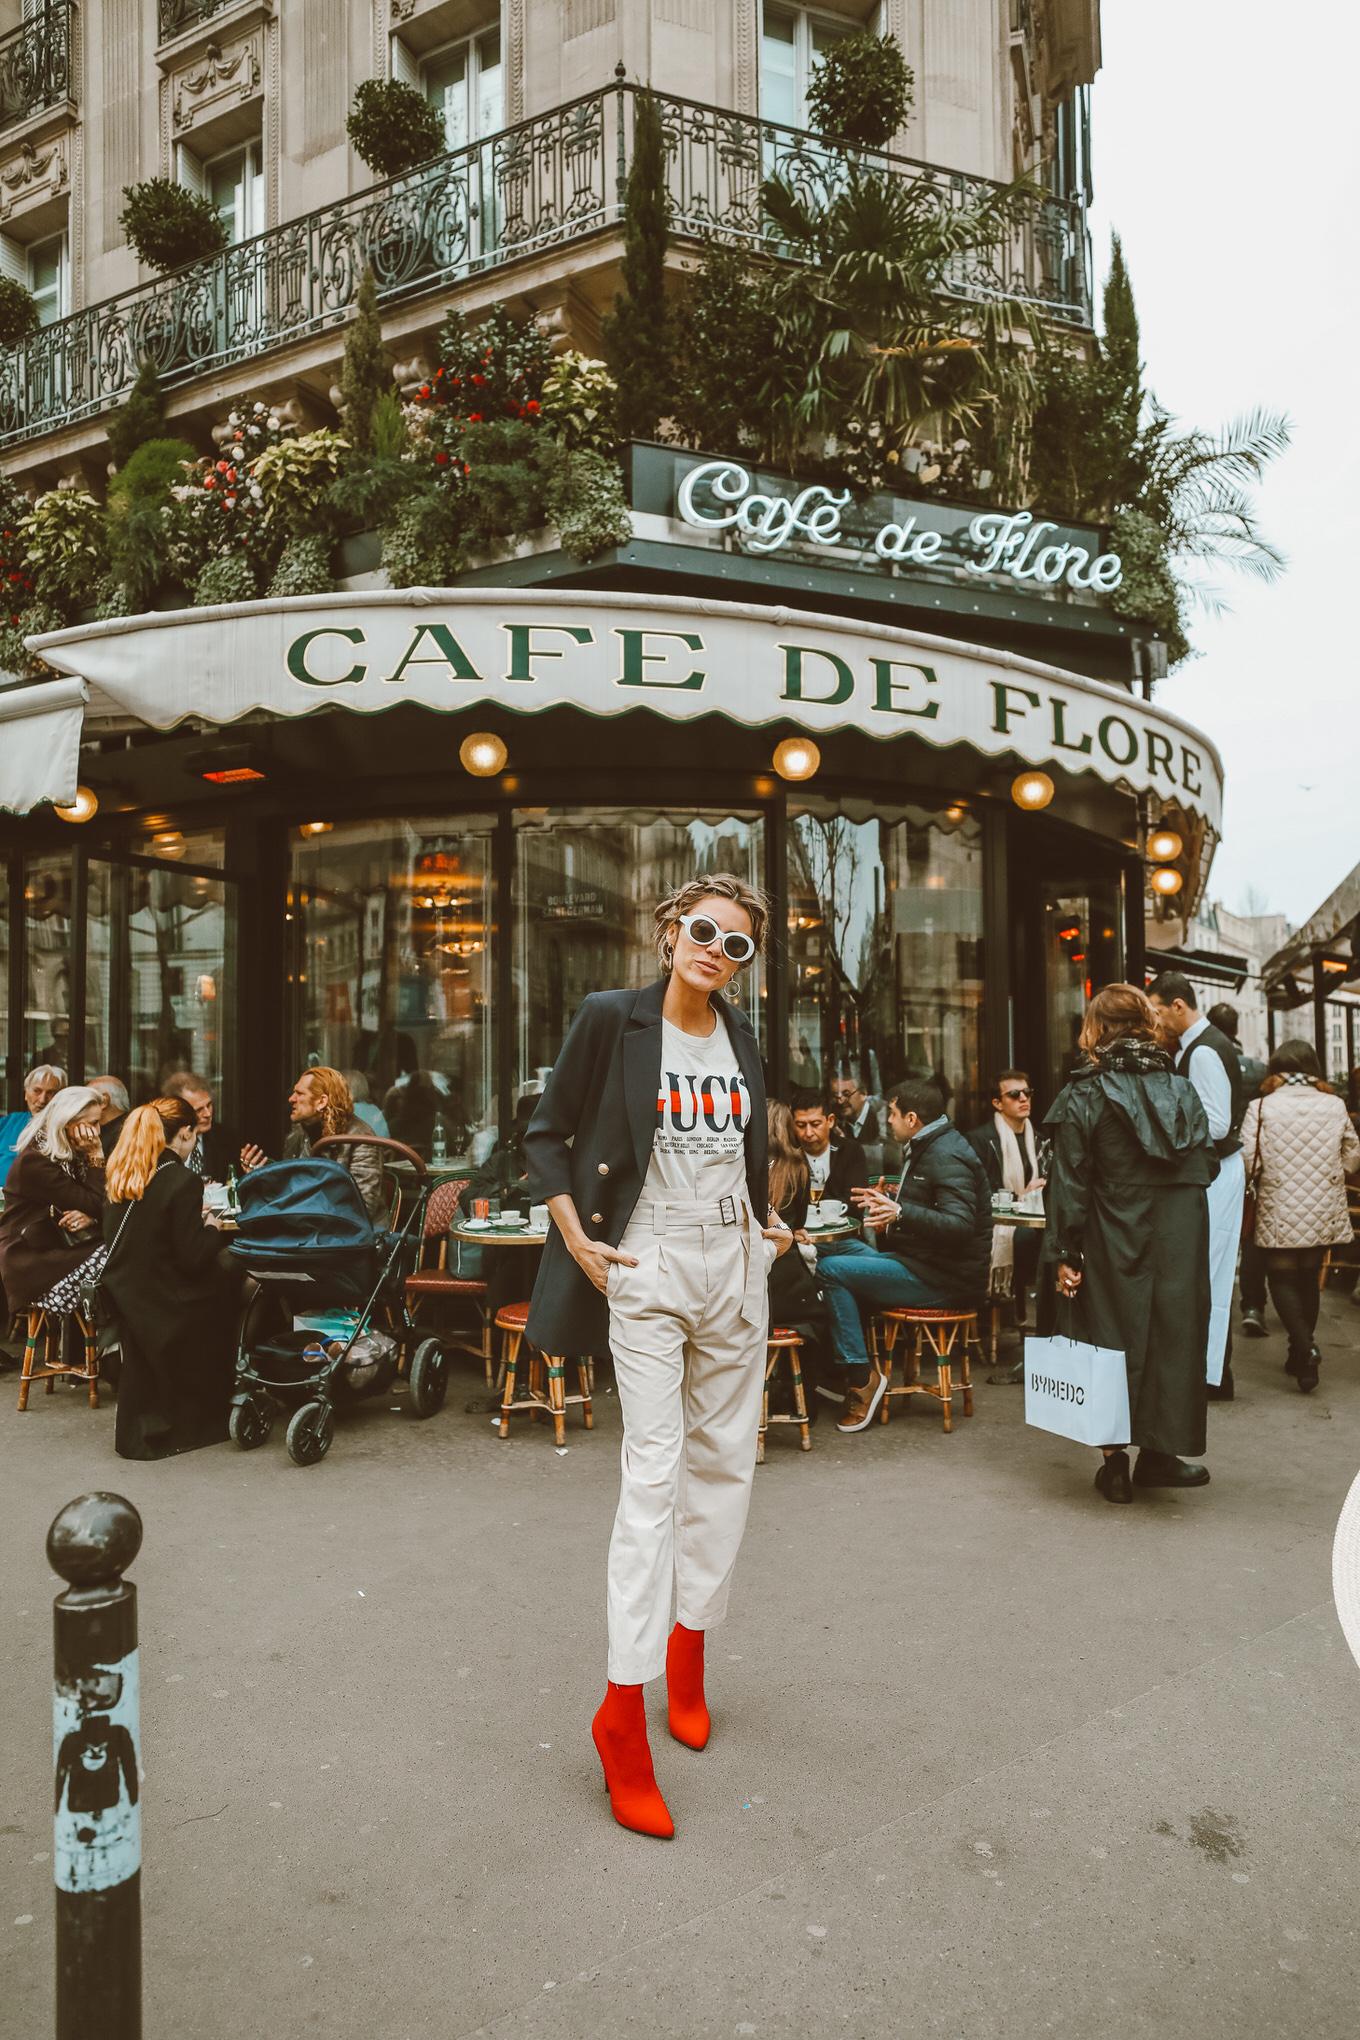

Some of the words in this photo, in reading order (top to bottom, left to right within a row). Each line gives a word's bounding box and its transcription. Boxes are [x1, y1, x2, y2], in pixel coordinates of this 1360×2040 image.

[875, 515, 943, 564] de
[964, 511, 1123, 593] Flore
[286, 623, 706, 691] CAFE
[774, 643, 941, 720] DE
[989, 680, 1203, 798] FLORE
[547, 892, 597, 906] BOULEVARD
[1031, 1372, 1085, 1406] BYREDO
